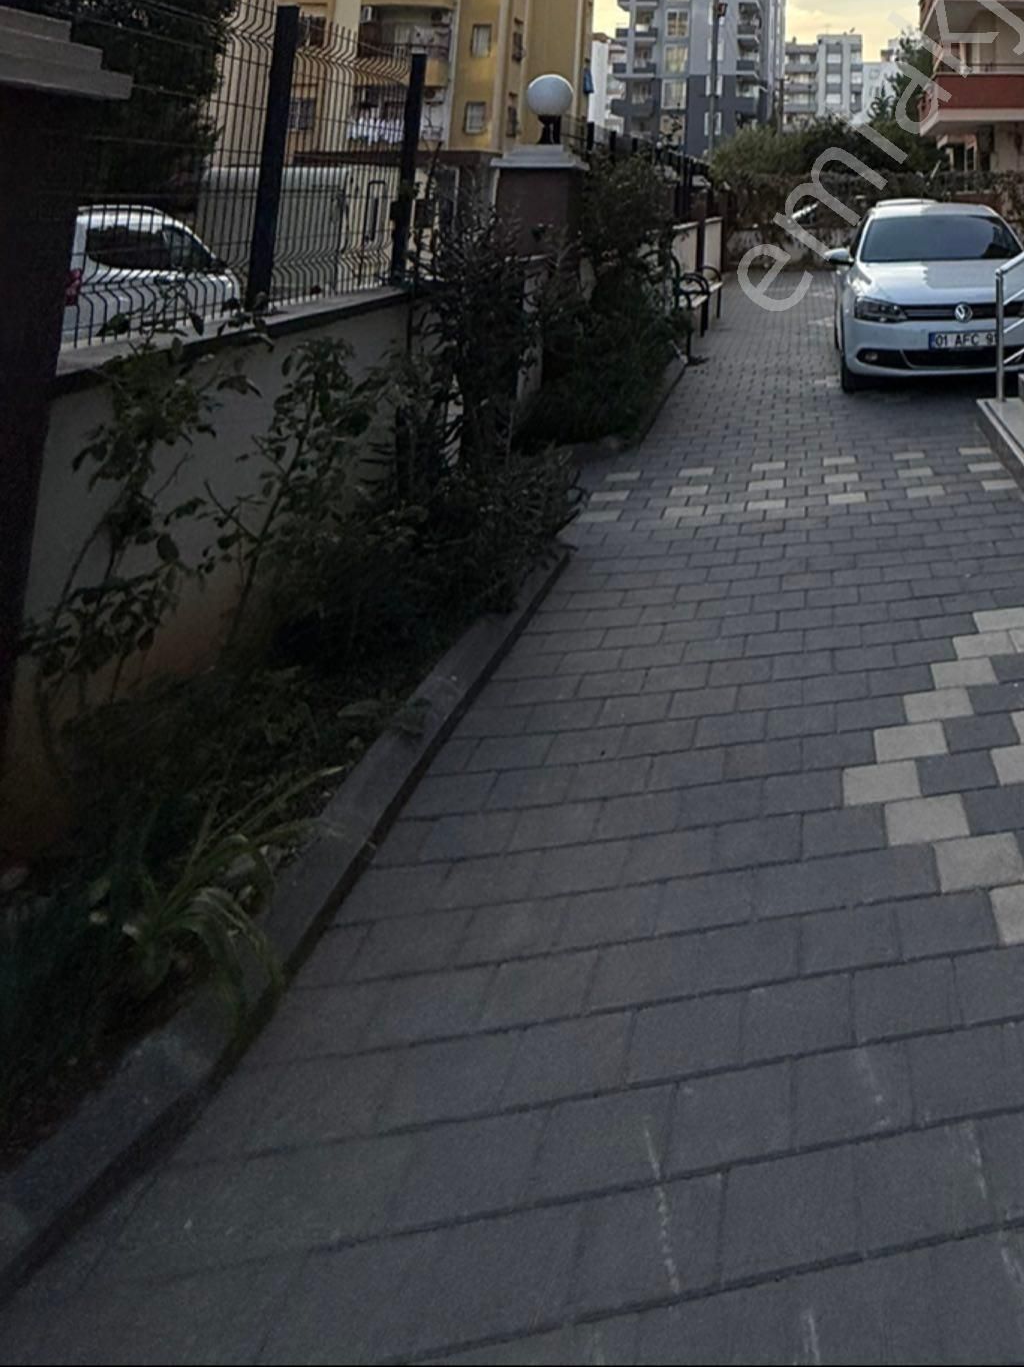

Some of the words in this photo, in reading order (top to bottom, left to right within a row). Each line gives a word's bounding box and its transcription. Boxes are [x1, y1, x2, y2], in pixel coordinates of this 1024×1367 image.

[935, 335, 948, 347] 01
[955, 334, 979, 346] AFC
[986, 333, 997, 345] 9
